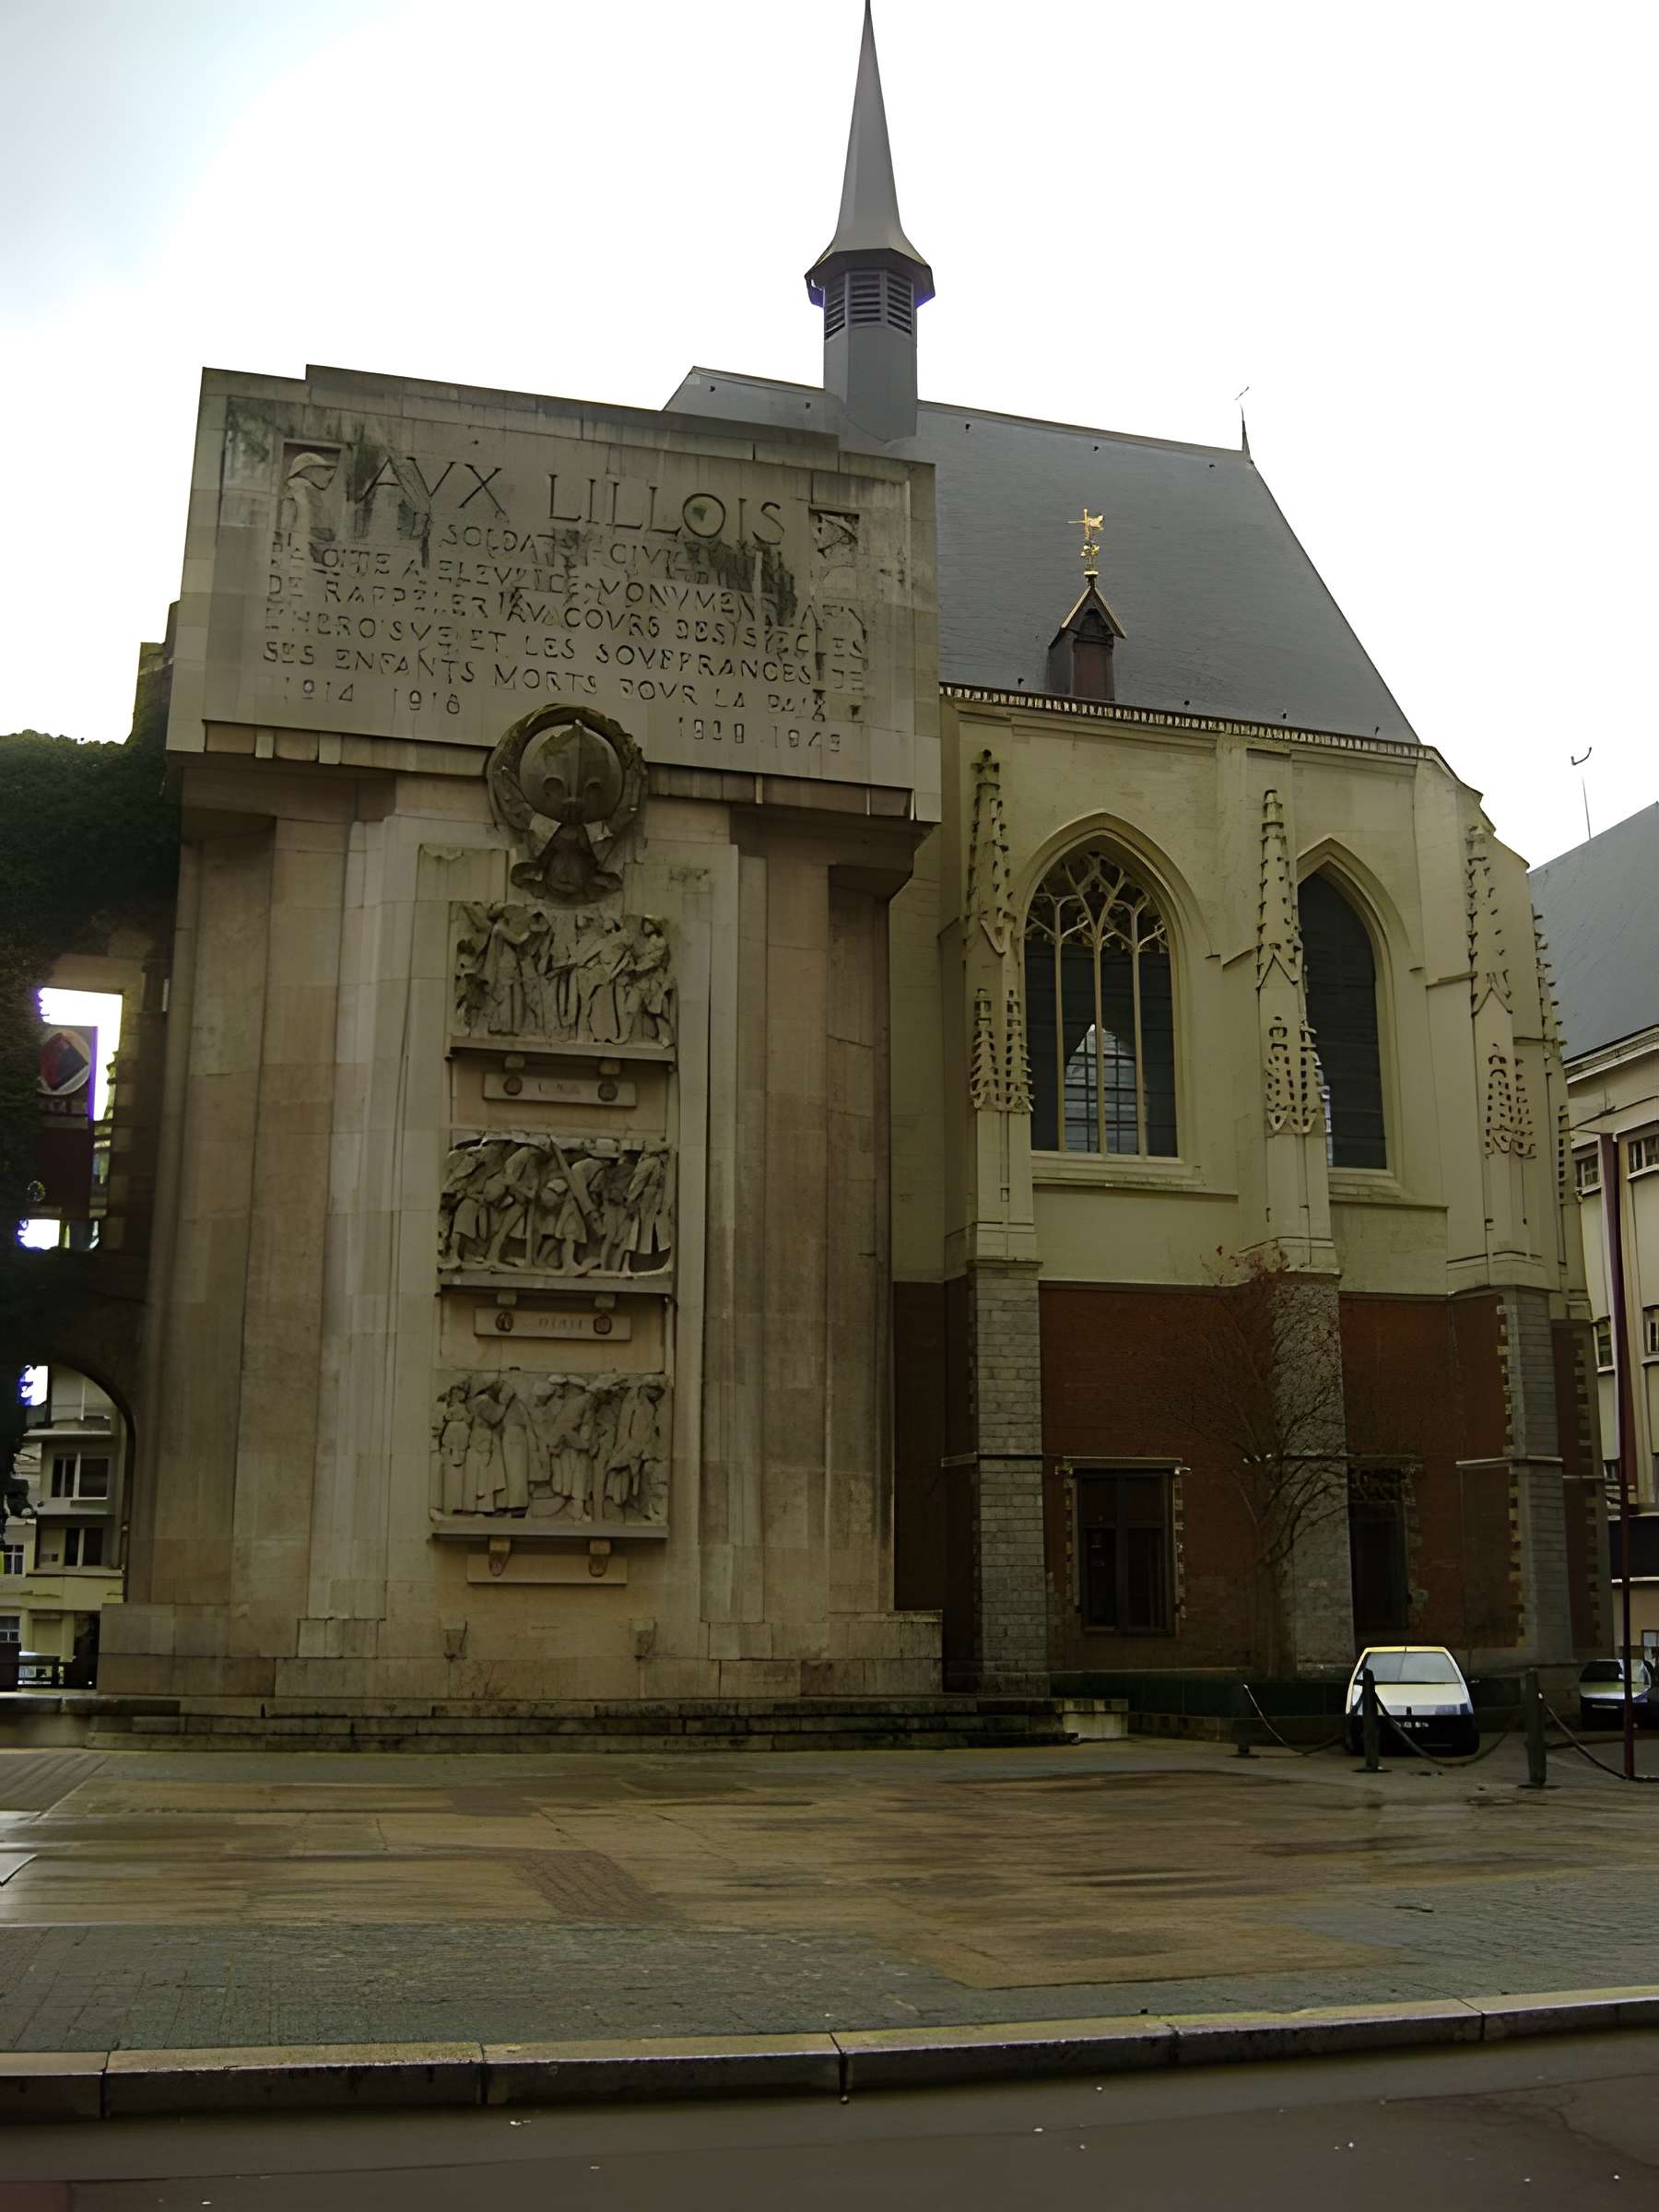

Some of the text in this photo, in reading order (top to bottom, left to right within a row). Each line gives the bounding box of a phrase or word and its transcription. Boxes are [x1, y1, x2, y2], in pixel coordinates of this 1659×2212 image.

[354, 456, 785, 546] AVX LILLOIS
[442, 524, 577, 569] SOLDAT
[609, 542, 706, 583] CIVIL
[264, 641, 315, 665] SES
[335, 648, 476, 685] ENFANTS
[715, 688, 747, 709] LA
[470, 629, 507, 653] ET
[524, 635, 575, 660] LES
